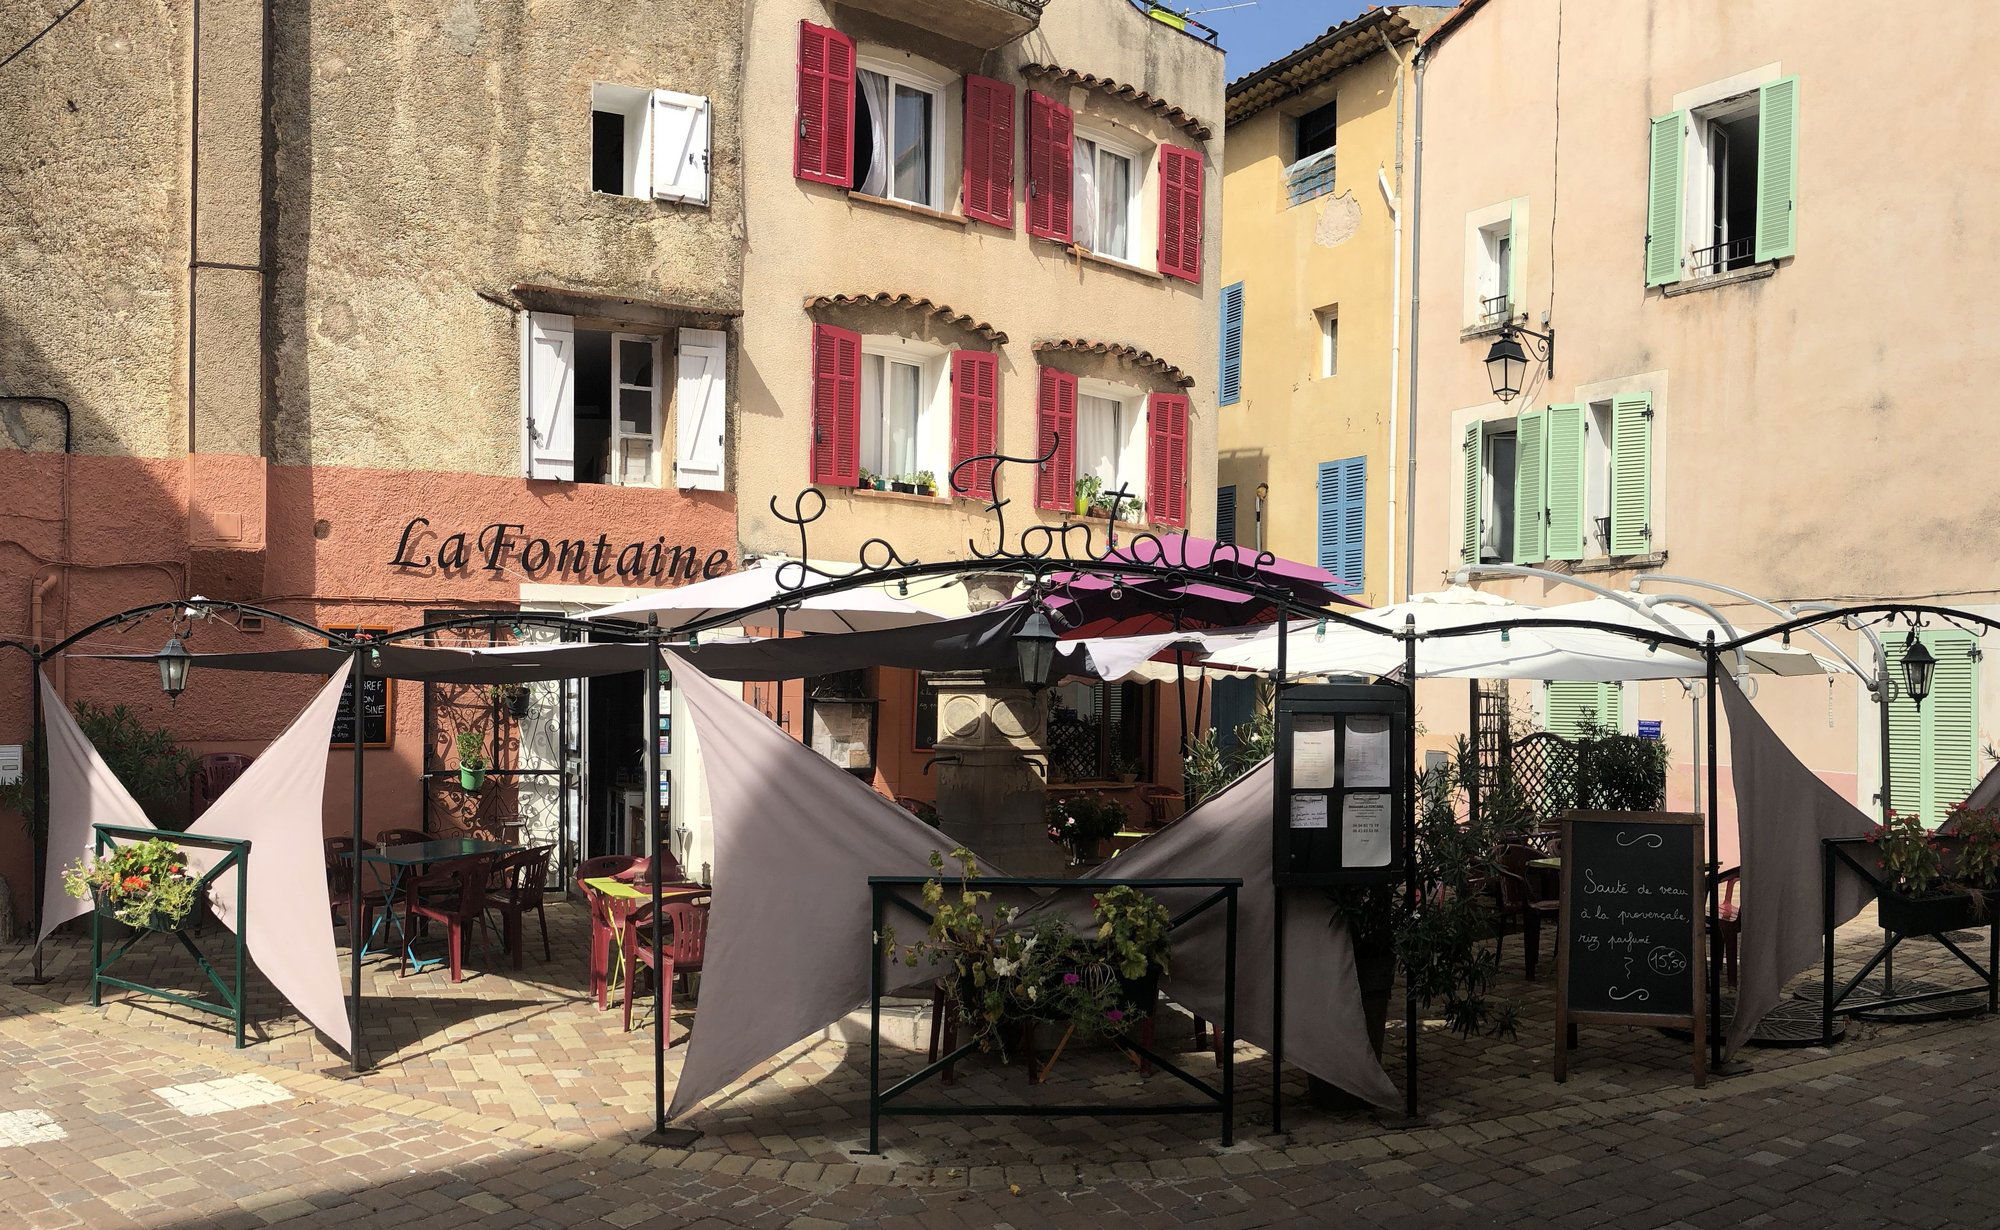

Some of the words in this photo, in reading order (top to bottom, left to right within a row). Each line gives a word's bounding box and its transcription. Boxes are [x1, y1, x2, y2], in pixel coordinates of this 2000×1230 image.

[387, 517, 467, 568] La
[478, 523, 729, 580] Fontaine
[770, 488, 920, 591] La
[1583, 868, 1629, 894] Sauté
[1637, 884, 1652, 895] de
[1659, 885, 1689, 895] veau
[1595, 905, 1609, 920] la
[1578, 932, 1601, 951] riz
[1608, 931, 1651, 951] parfumé
